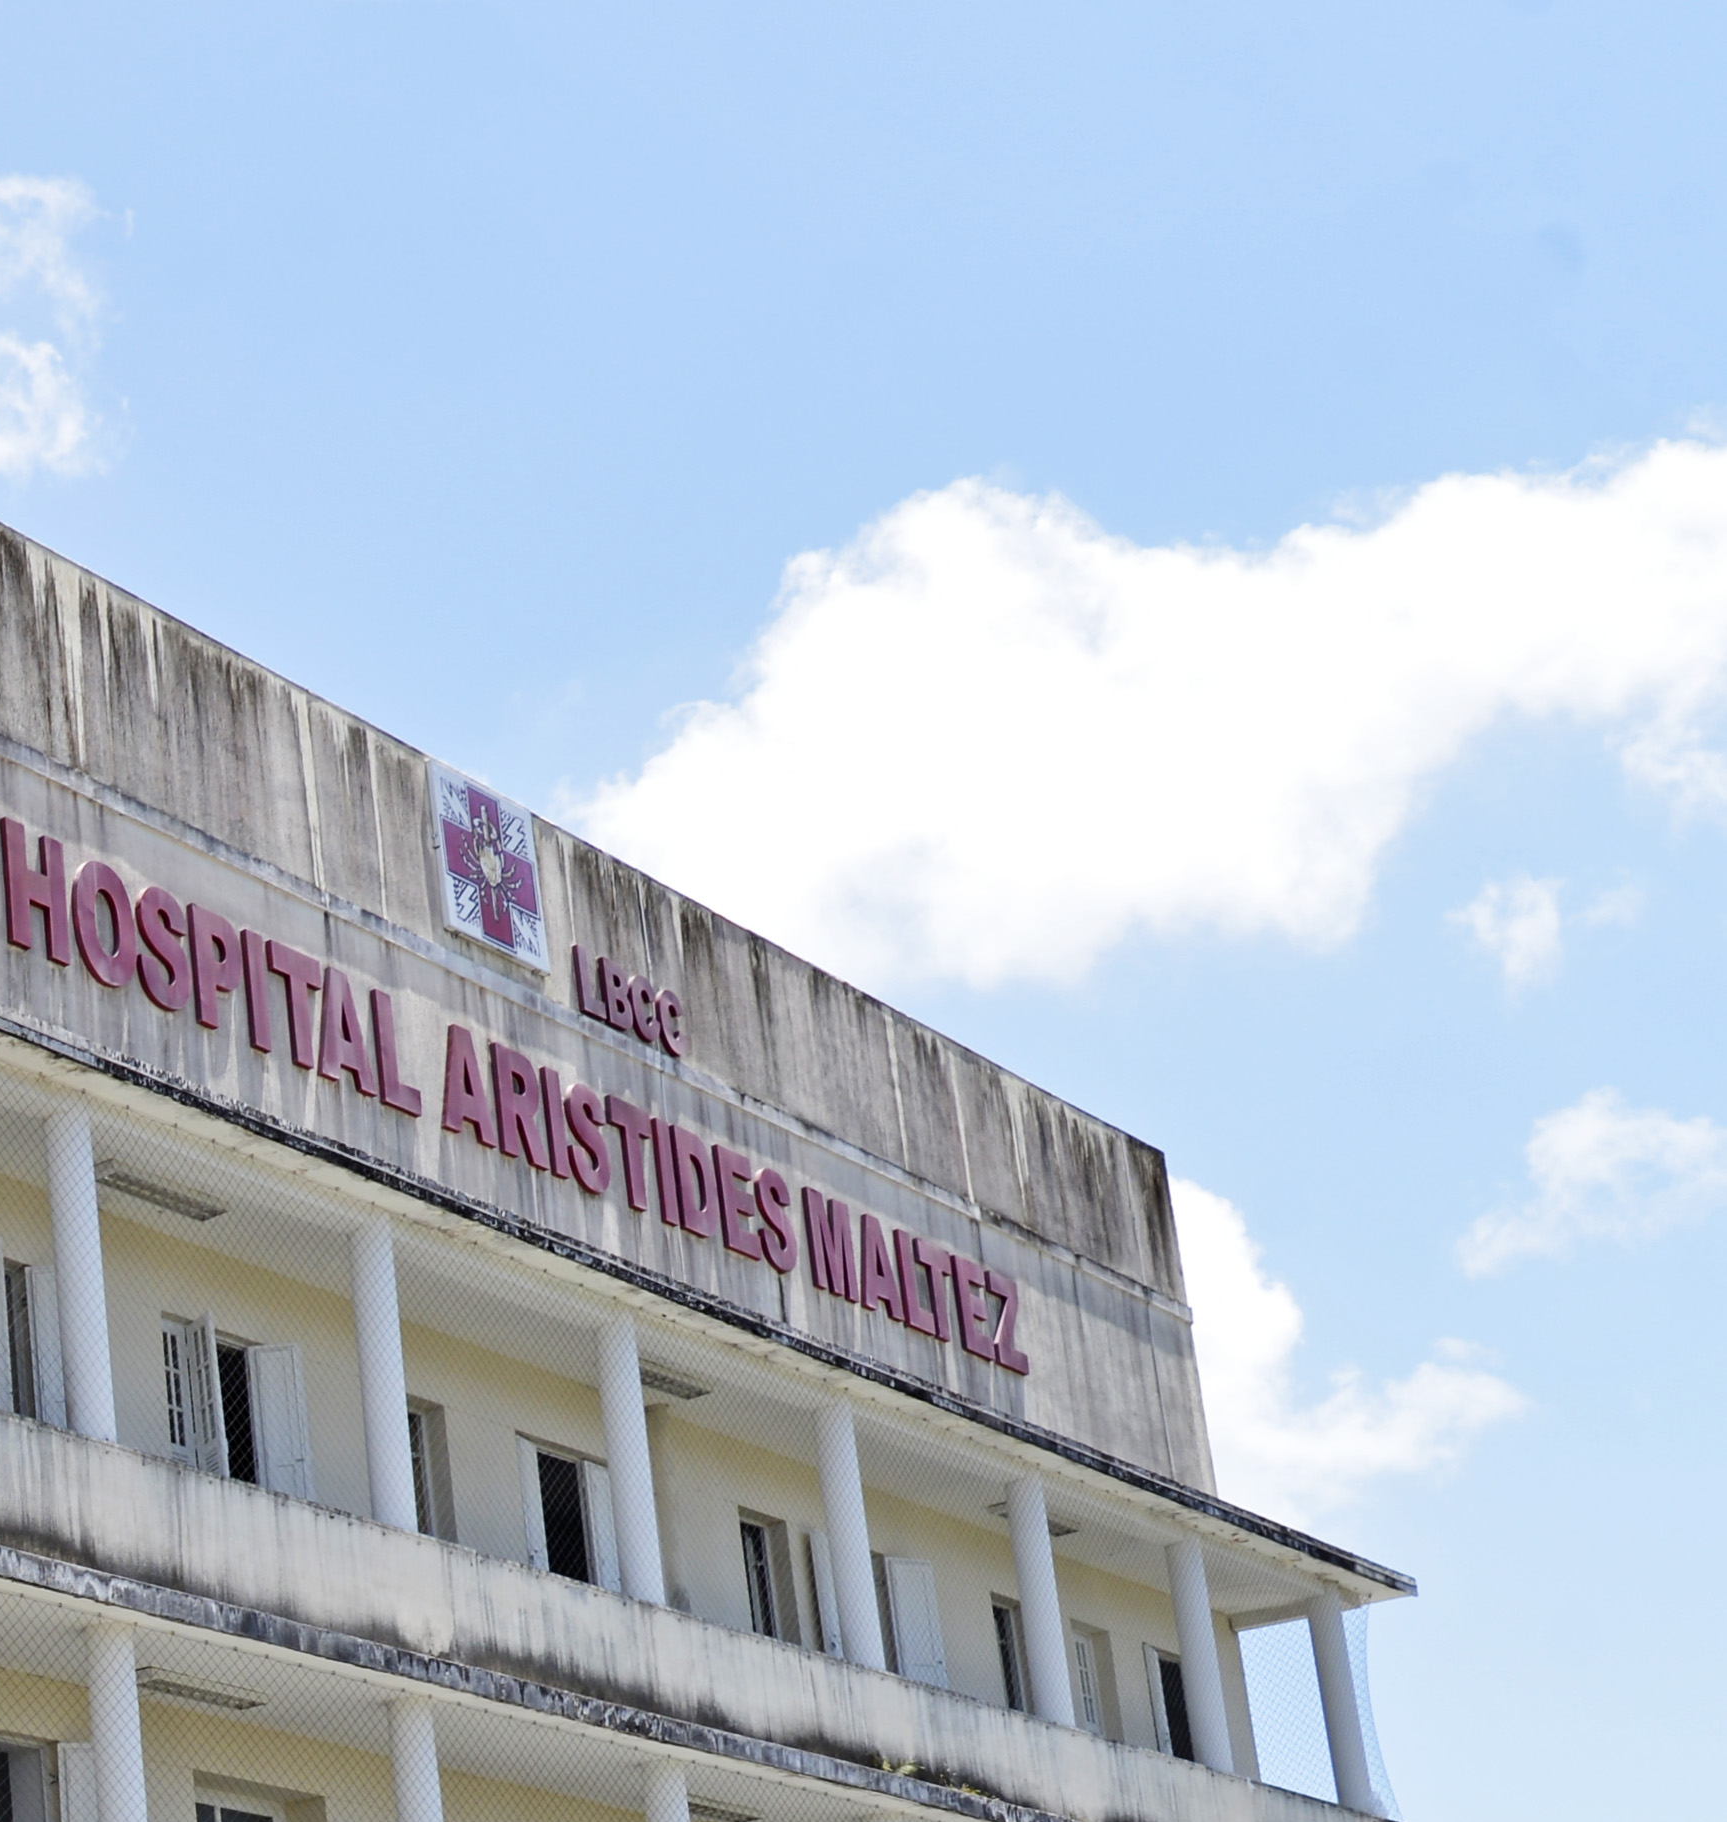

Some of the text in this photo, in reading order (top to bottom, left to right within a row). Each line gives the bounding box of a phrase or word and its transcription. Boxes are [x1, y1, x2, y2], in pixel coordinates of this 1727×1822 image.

[0, 815, 1030, 1376] HOSPITAL ARISTIDES MALTEZ
[572, 944, 690, 1058] LBCC
